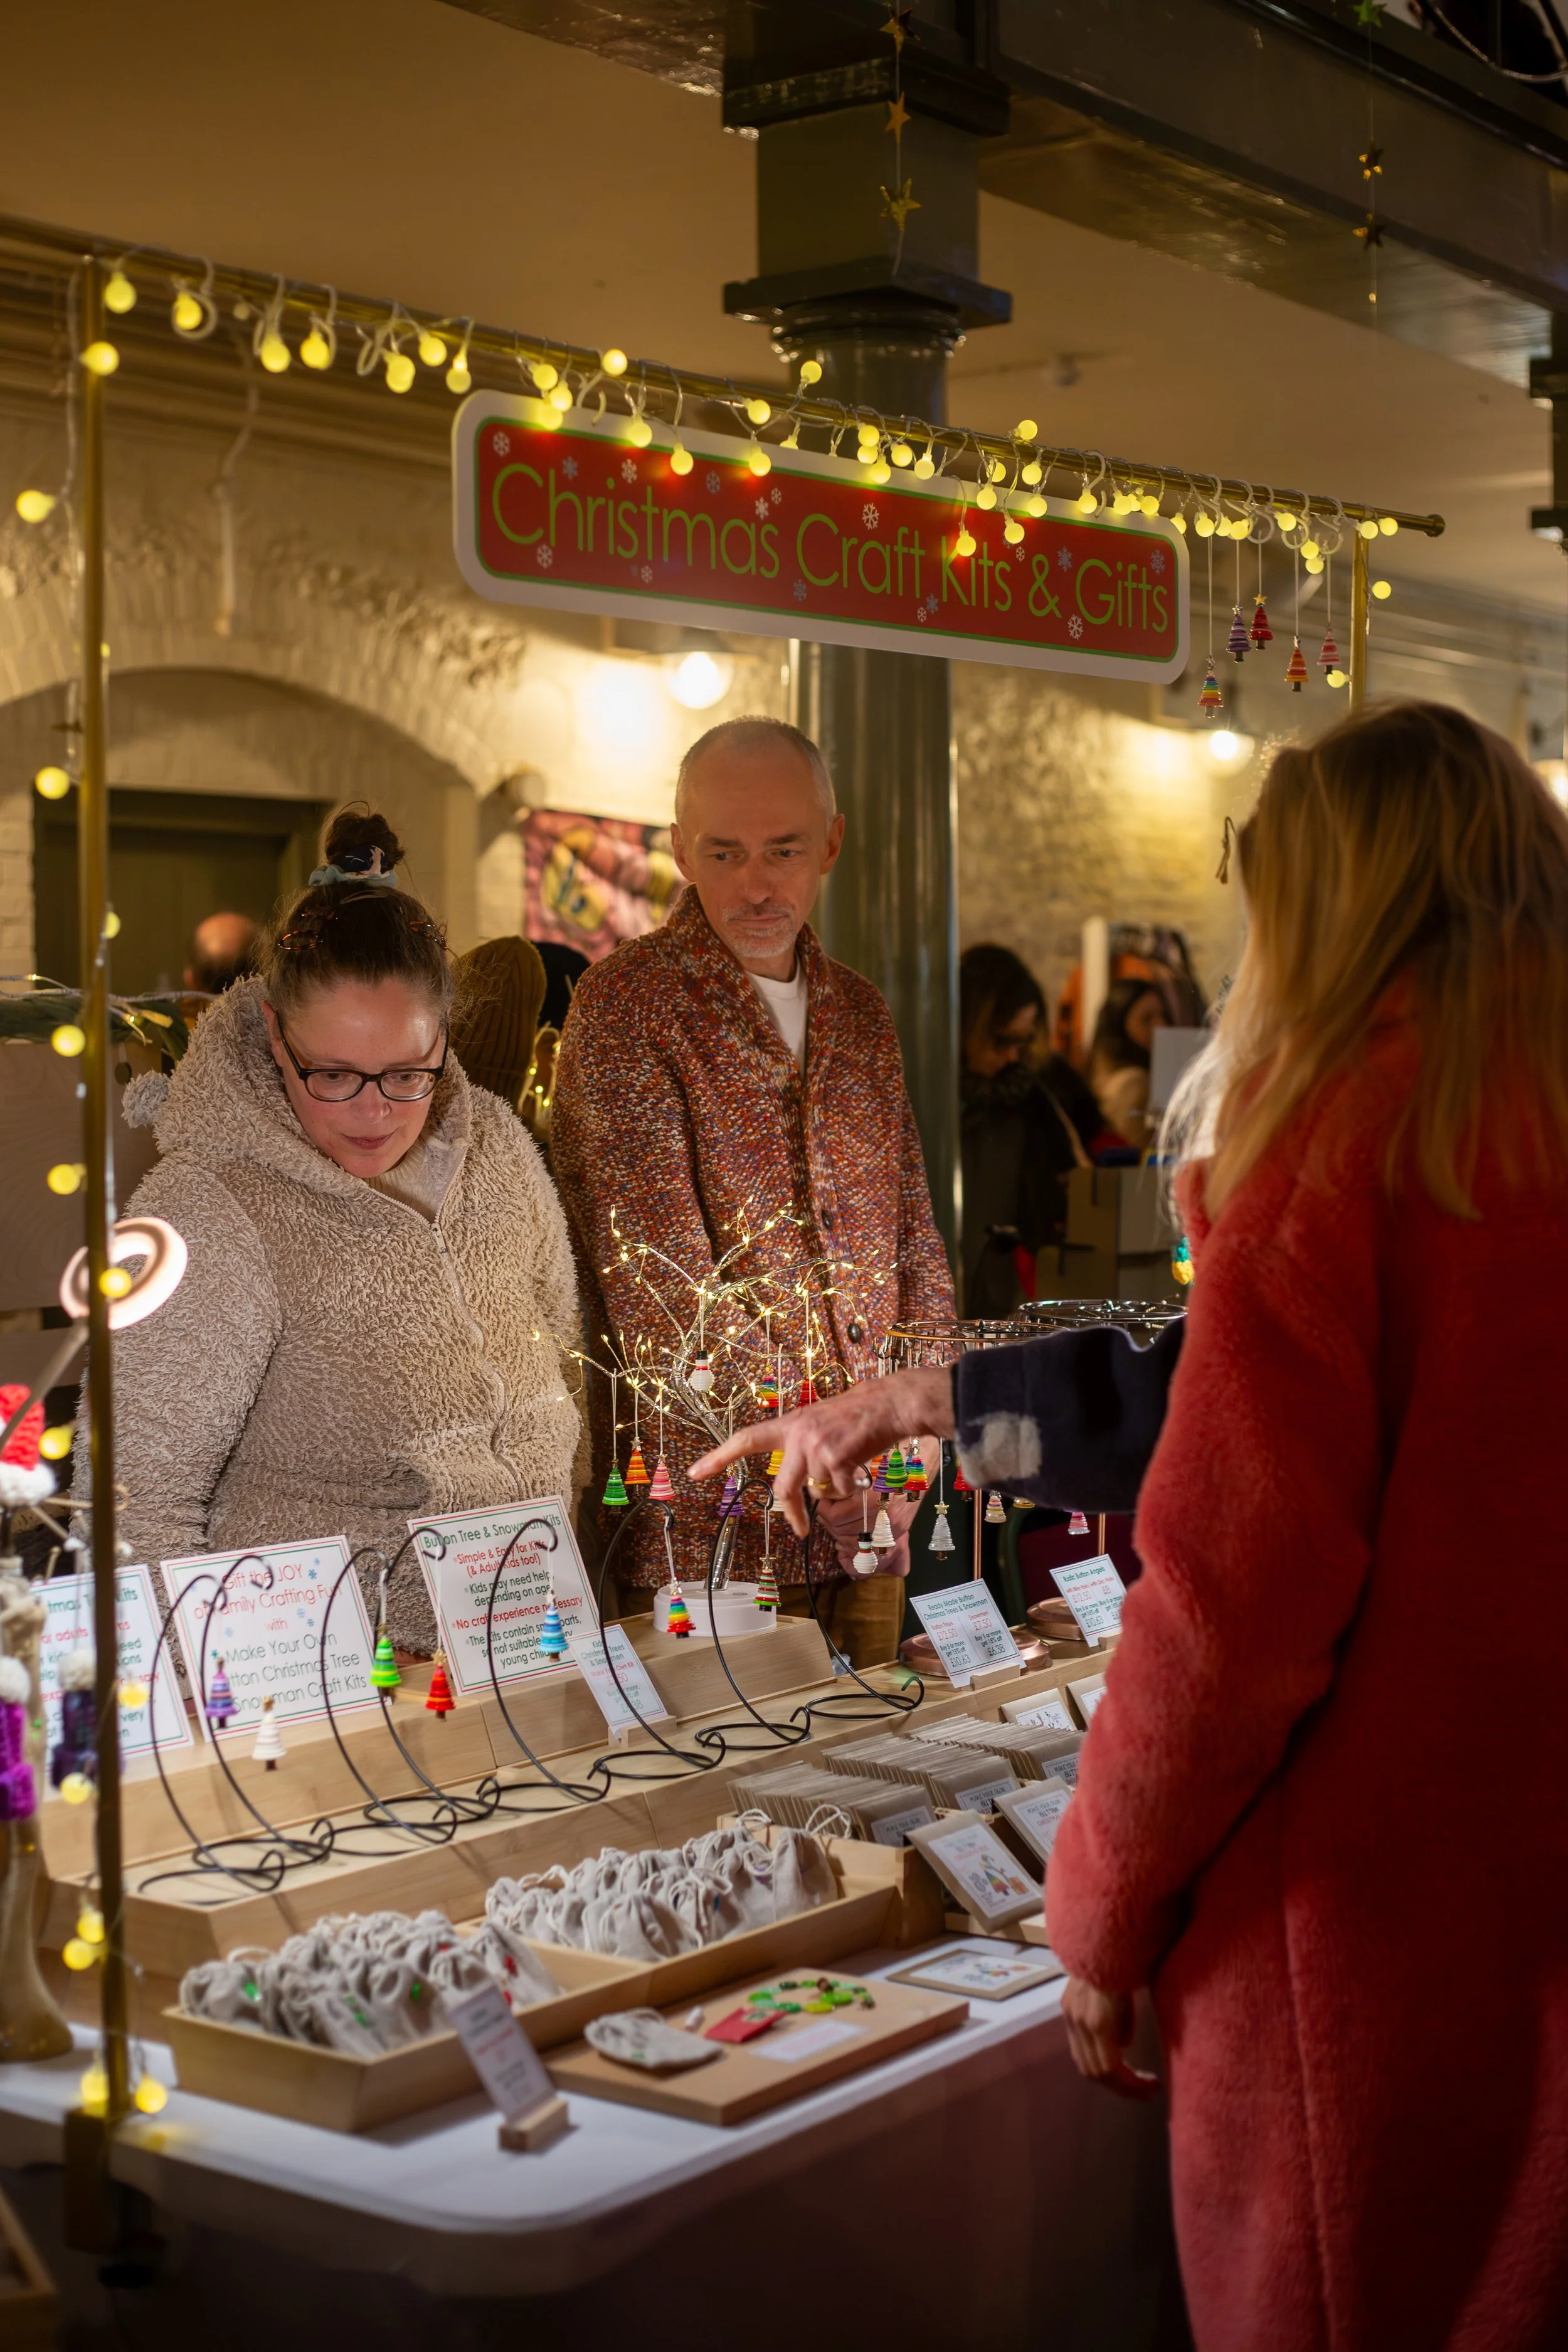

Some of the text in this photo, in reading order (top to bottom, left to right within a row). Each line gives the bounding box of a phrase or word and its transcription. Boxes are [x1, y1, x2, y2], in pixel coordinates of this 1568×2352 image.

[492, 462, 1168, 633] Christmas Craft Kits & Gifts
[423, 1534, 458, 1549] Buton
[458, 1530, 481, 1542] Tree
[483, 1526, 492, 1538] &
[543, 1514, 562, 1527] Kits
[457, 1540, 546, 1565] Simple & Eay for Kids
[467, 1565, 478, 1578] (&
[502, 1557, 520, 1569] Kids
[521, 1552, 542, 1565] too!)
[221, 1572, 247, 1591] Gift
[278, 1563, 303, 1582] JOY
[469, 1582, 488, 1595] Kids
[510, 1572, 532, 1587] need
[213, 1596, 256, 1617] amily
[259, 1588, 316, 1608] Crafting
[317, 1583, 343, 1600] Fun
[474, 1584, 551, 1607] depending on age
[928, 1594, 975, 1612] Ready Made Button
[455, 1618, 470, 1630] No
[472, 1614, 489, 1627] craf
[492, 1605, 540, 1623] experience
[924, 1609, 946, 1621] Christmas
[946, 1607, 959, 1616] Trees
[963, 1599, 988, 1610] Snowmen
[55, 1626, 88, 1642] adults
[263, 1617, 289, 1631] with
[469, 1634, 486, 1646] The
[489, 1630, 501, 1643] its
[503, 1624, 536, 1638] contain
[973, 1618, 992, 1631] £7.50
[118, 1638, 142, 1651] eed
[226, 1633, 337, 1663] Make Your Own
[494, 1644, 508, 1655] not
[509, 1636, 541, 1651] suitable
[609, 1644, 625, 1653] Trees
[987, 1644, 1006, 1656] £6.38
[230, 1653, 360, 1688] tton Christmas Tree
[501, 1652, 529, 1669] young
[595, 1653, 625, 1666] Snomen
[950, 1655, 972, 1668] £10.63
[233, 1673, 368, 1713] Snoman Craft Kits
[120, 1710, 144, 1723] very
